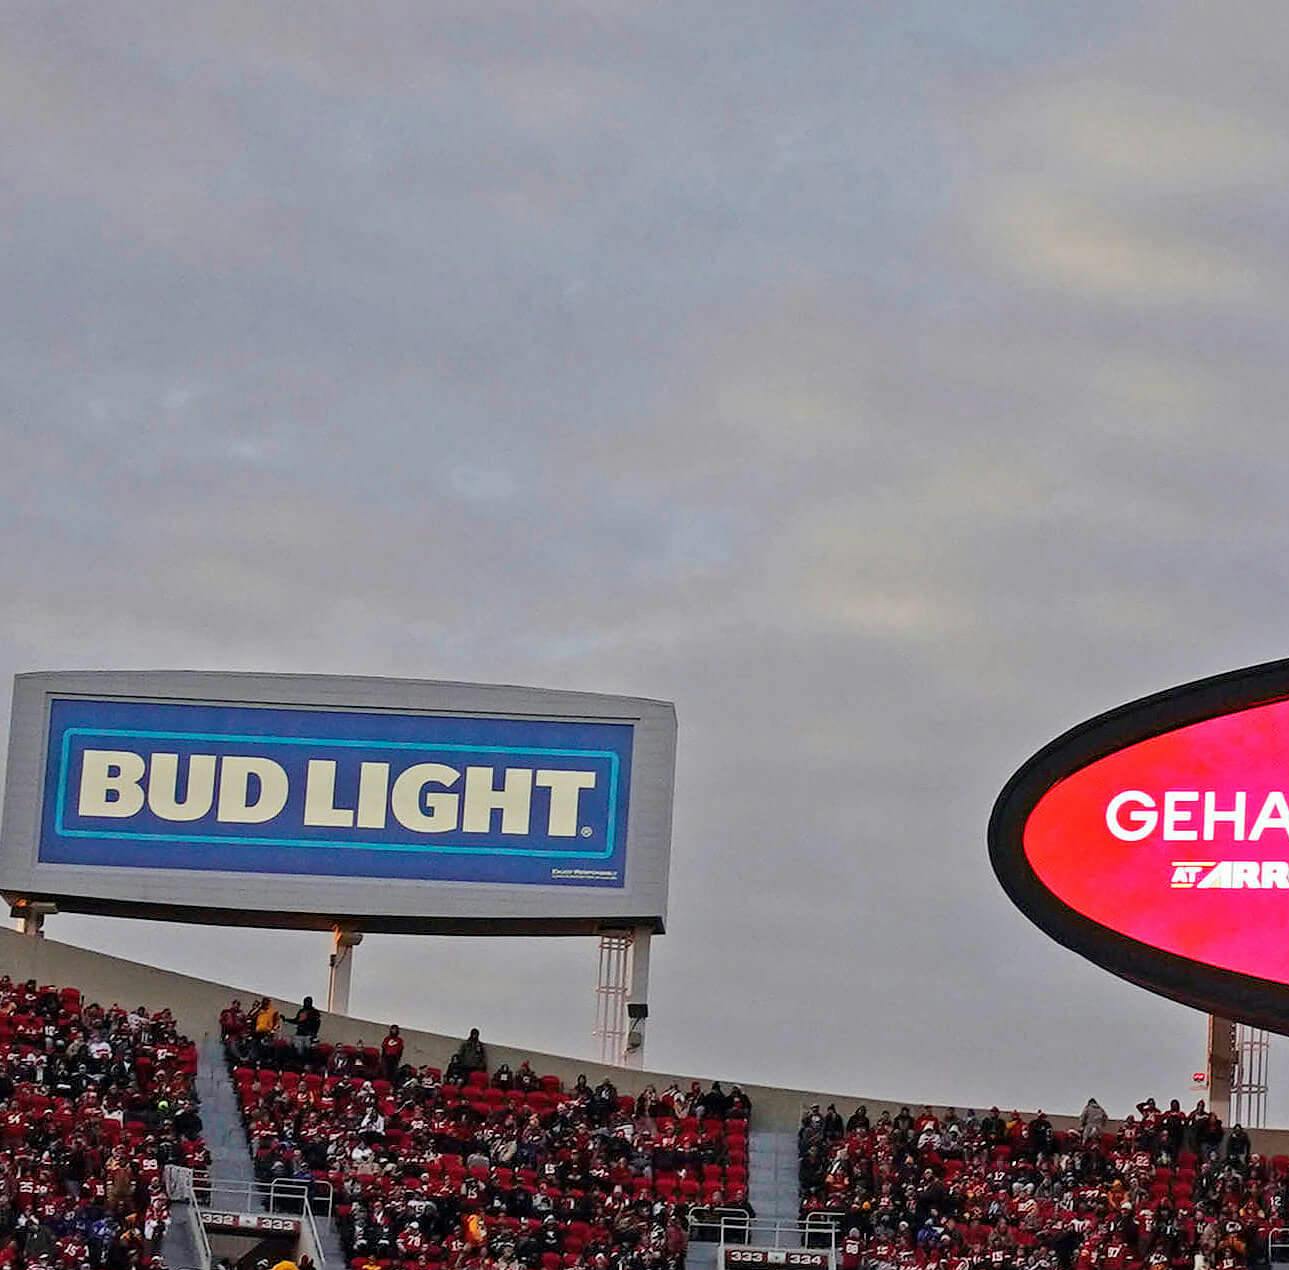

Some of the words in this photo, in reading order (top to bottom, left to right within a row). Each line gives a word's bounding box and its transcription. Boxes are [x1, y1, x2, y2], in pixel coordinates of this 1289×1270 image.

[78, 749, 289, 824] BUD
[304, 759, 596, 837] LIGHT
[1172, 865, 1200, 886] AT
[1270, 1197, 1281, 1206] 12
[202, 1214, 235, 1225] 332
[262, 1219, 294, 1230] 333
[731, 1251, 763, 1262] 333
